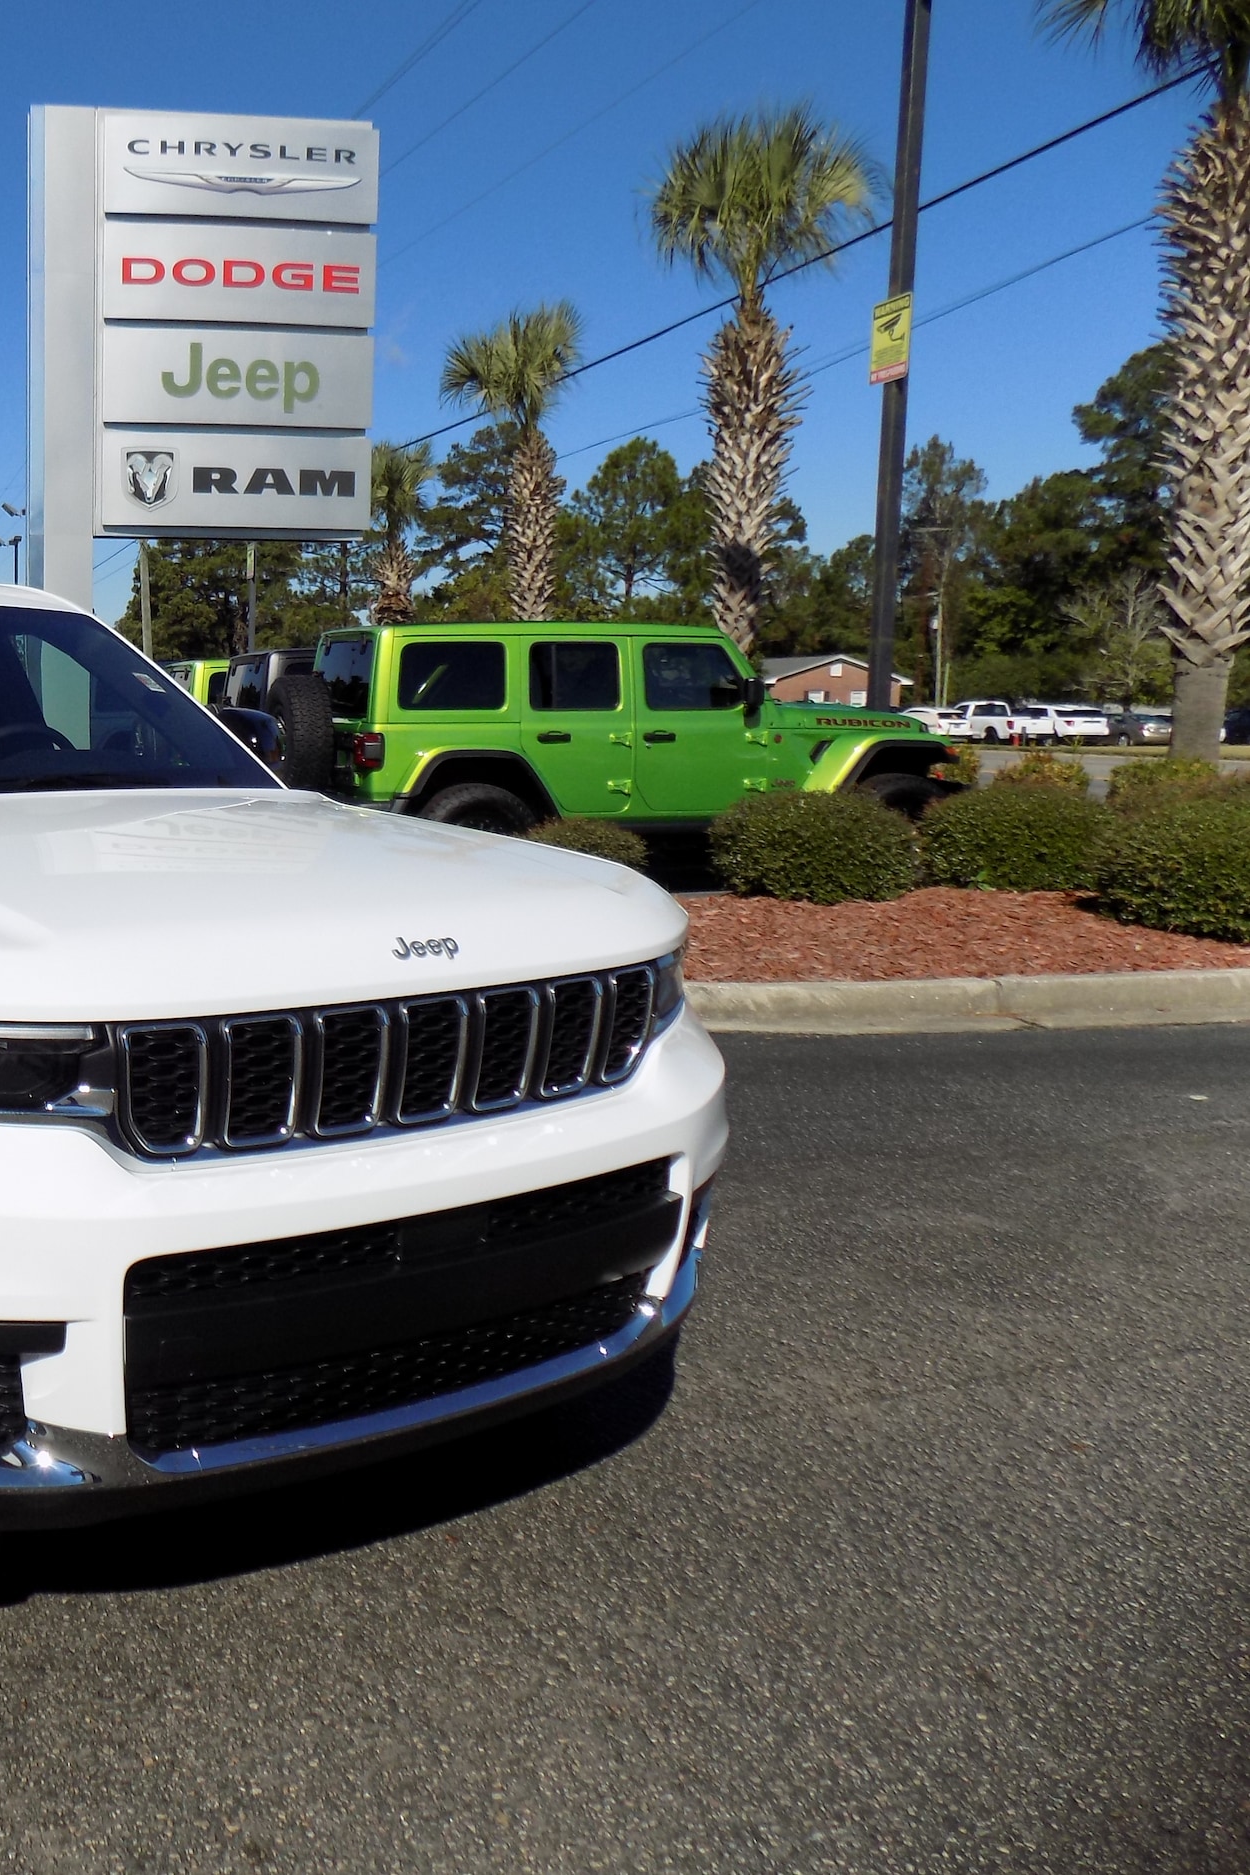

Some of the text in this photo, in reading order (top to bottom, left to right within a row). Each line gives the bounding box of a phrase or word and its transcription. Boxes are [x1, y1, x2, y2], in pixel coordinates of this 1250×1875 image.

[127, 139, 357, 165] CHRYSLER
[121, 257, 360, 294] DODGE
[161, 342, 320, 414] Jeep
[192, 466, 355, 497] RAM
[815, 717, 911, 729] RUBICON
[391, 936, 459, 960] Jeep
